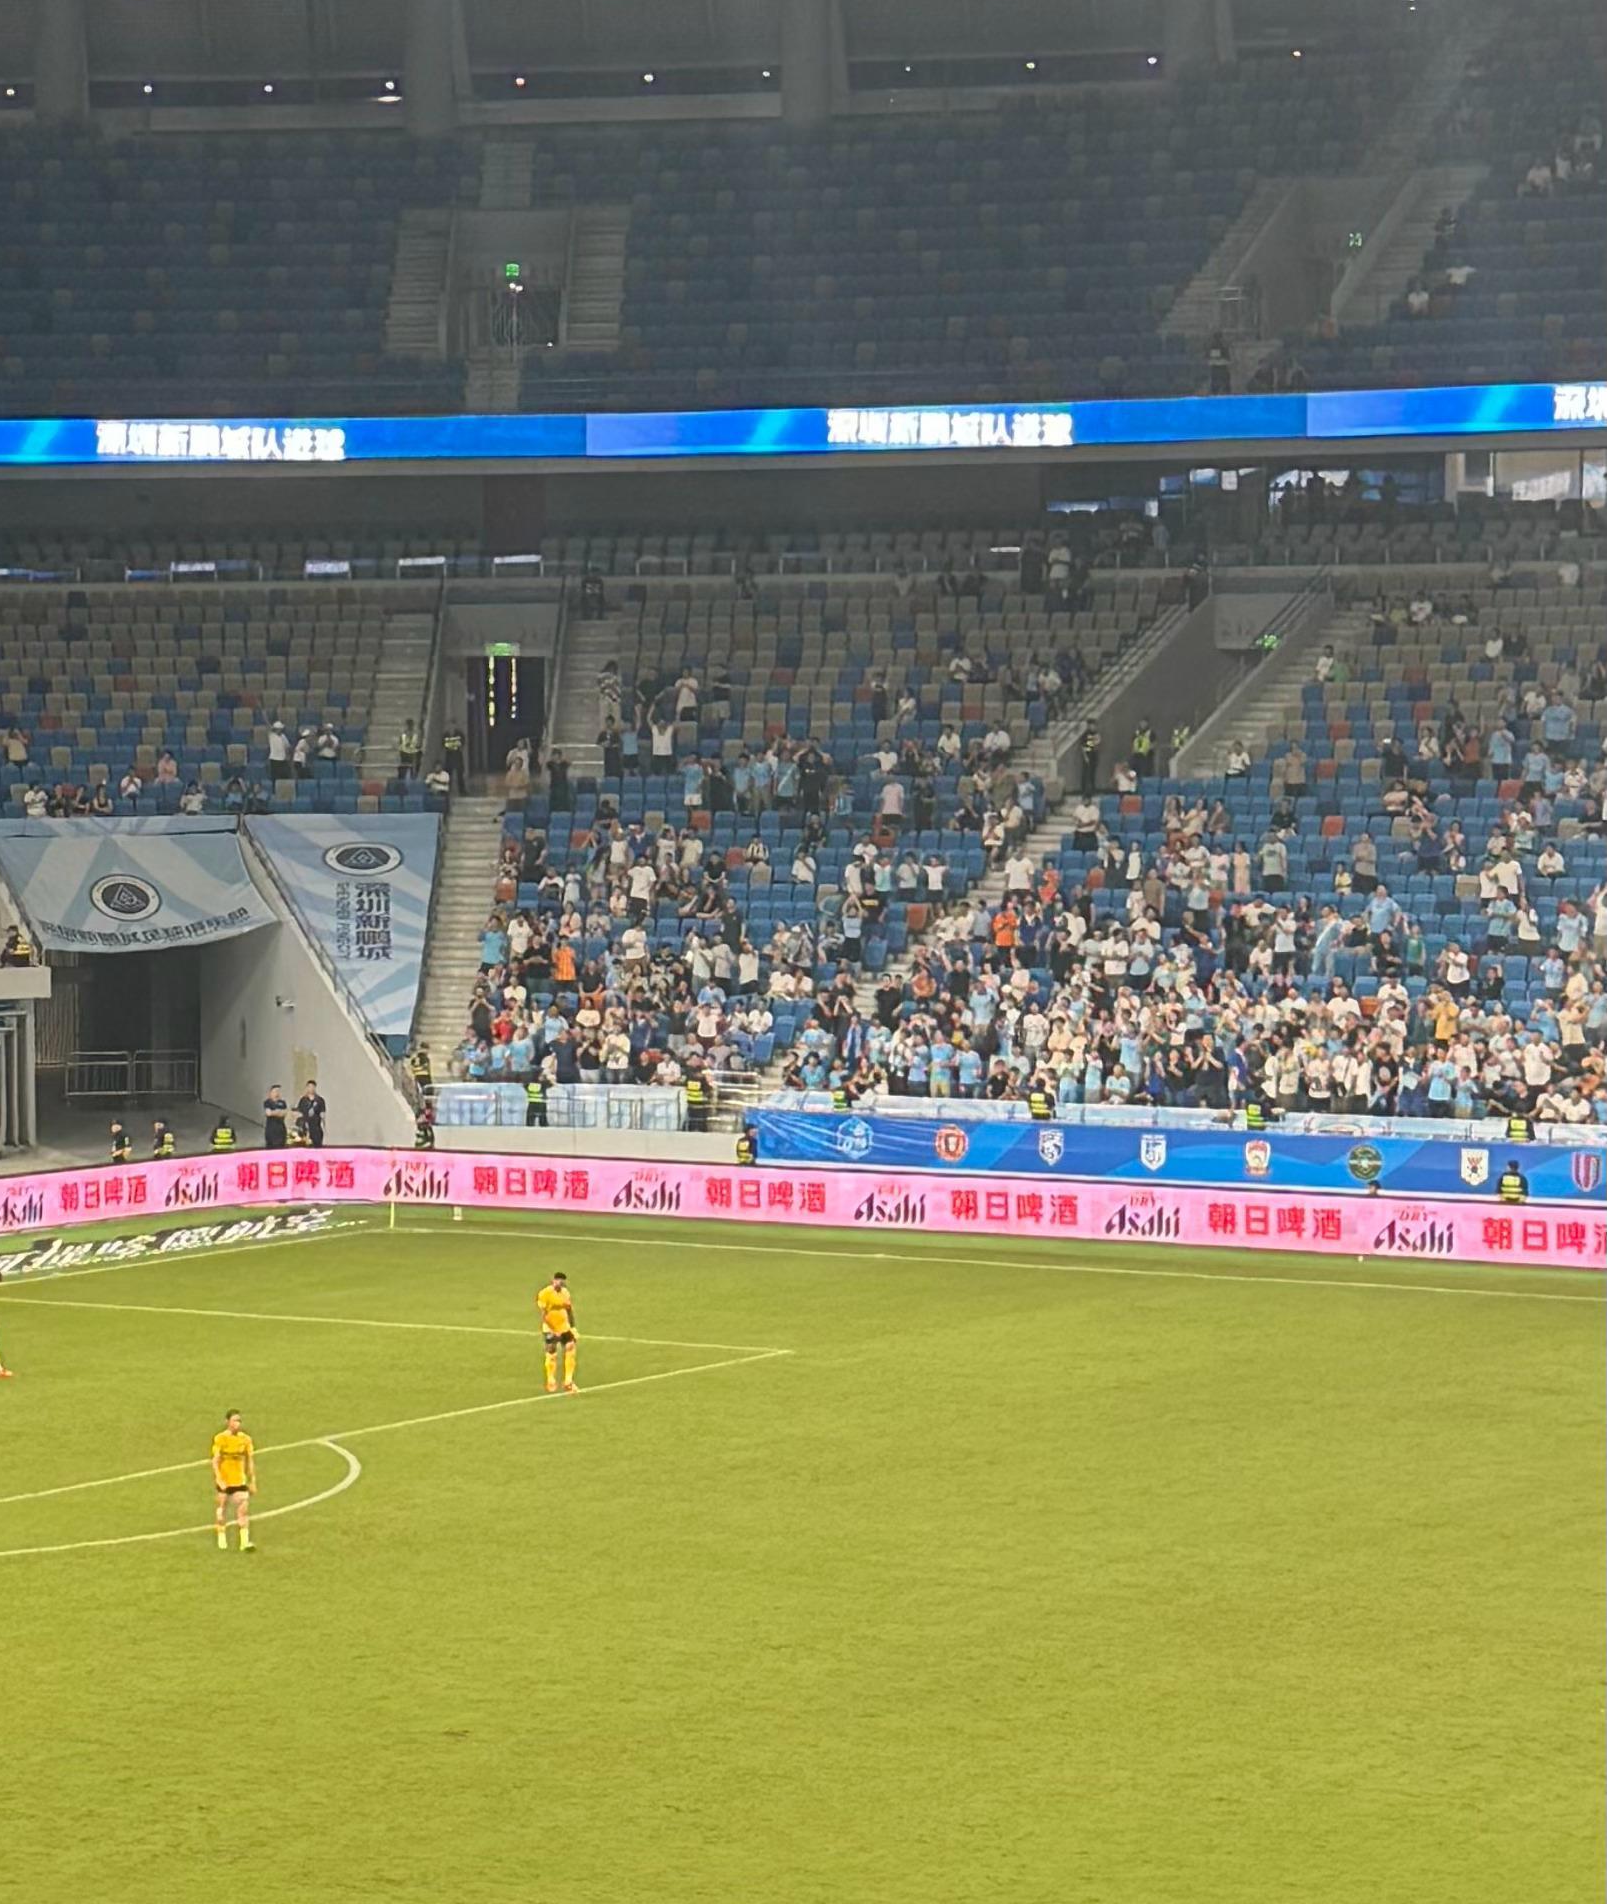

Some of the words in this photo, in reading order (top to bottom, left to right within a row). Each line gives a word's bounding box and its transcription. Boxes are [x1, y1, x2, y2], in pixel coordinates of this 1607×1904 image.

[59, 1174, 147, 1211] 朝日啤酒
[165, 1170, 219, 1207] Asahi
[237, 1159, 355, 1191] 朝日啤酒
[383, 1167, 450, 1200] Asahi
[473, 1165, 590, 1200] 朝日啤酒
[612, 1178, 682, 1211] Asahi
[705, 1177, 827, 1214] 朝日啤酒
[854, 1192, 926, 1224] Asahi
[950, 1189, 1079, 1226] 朝日啤酒
[1105, 1204, 1181, 1238] Asahi
[1208, 1202, 1342, 1240] 朝日啤酒
[1373, 1218, 1454, 1254] Asahi
